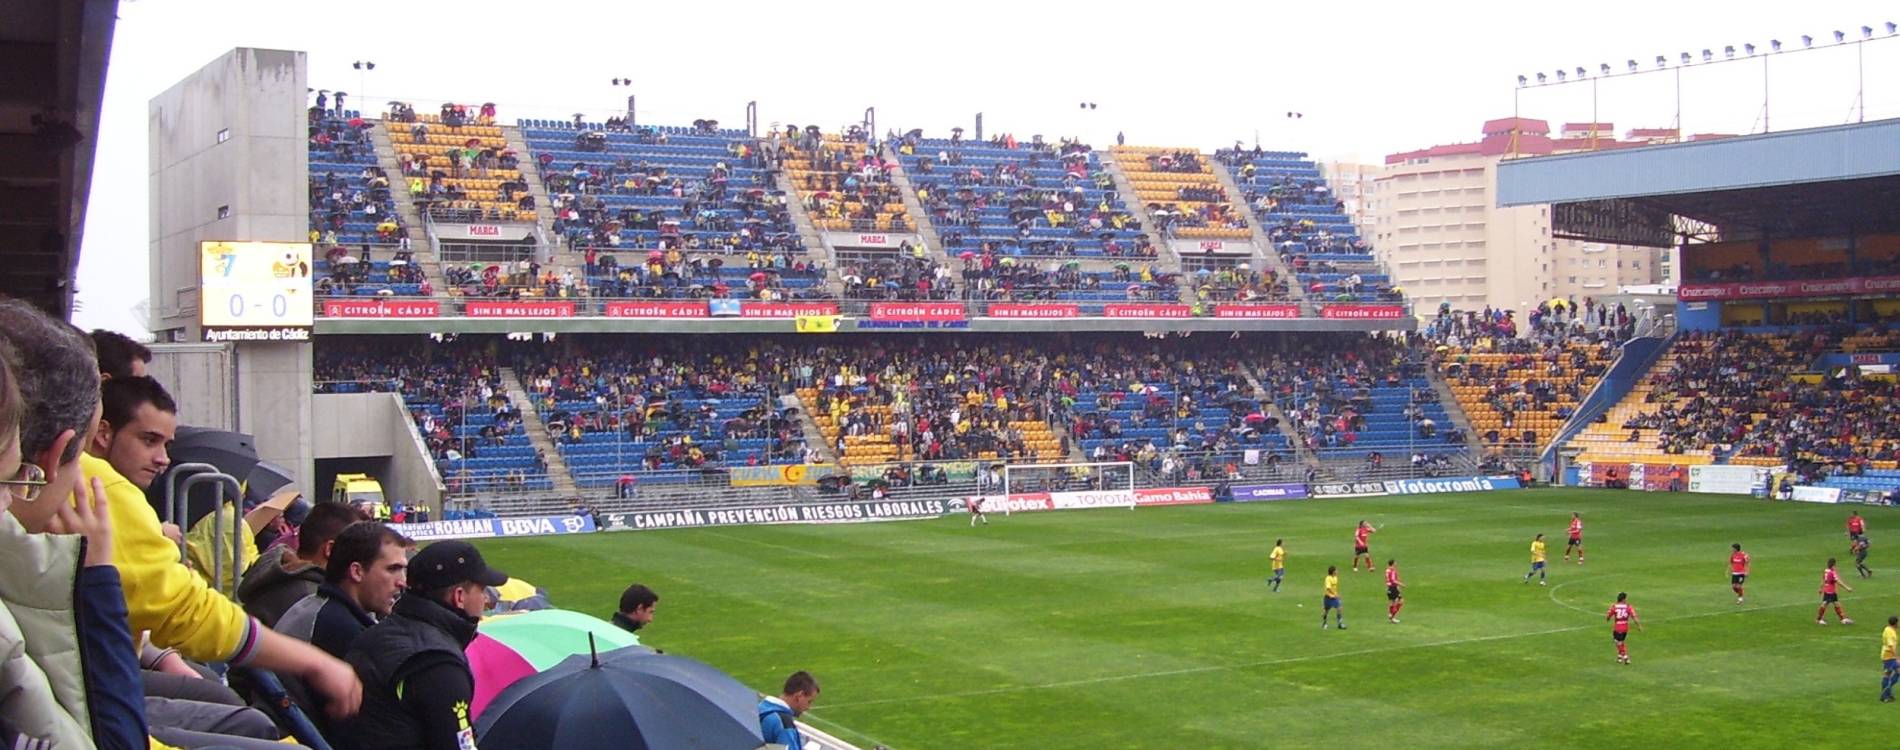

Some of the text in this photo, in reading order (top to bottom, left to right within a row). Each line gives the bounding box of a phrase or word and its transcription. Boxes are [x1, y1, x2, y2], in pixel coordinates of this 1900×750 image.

[469, 225, 499, 235] MARCA
[860, 235, 887, 244] MARCA
[229, 293, 244, 317] 0
[273, 293, 287, 317] 0
[344, 305, 435, 315] CITROËN CÁDIZ
[473, 307, 491, 315] SIN
[505, 307, 527, 315] MAS
[528, 307, 556, 316] LEJOS
[623, 305, 705, 316] CITROËN CÁDIZ
[745, 308, 761, 316] SIN
[774, 308, 794, 317] MAS
[886, 306, 961, 316] CITROËN CÁDIZ
[994, 308, 1008, 317] SIN
[1020, 309, 1039, 317] MAS
[1039, 309, 1064, 317] LEJOS
[1118, 308, 1188, 317] CITROËN CÁDIZ
[1335, 309, 1399, 317] CITROËN CÁDIZ
[206, 328, 309, 342] Ayuntamiento de Cádiz
[1399, 477, 1494, 495] fotocromía
[1075, 494, 1132, 506] TOYOTA
[634, 500, 944, 528] CAMPAÑA PREVENCIÓN RIESGOS LABORALES
[435, 518, 494, 535] RO&MAN
[502, 518, 556, 535] BBVA
